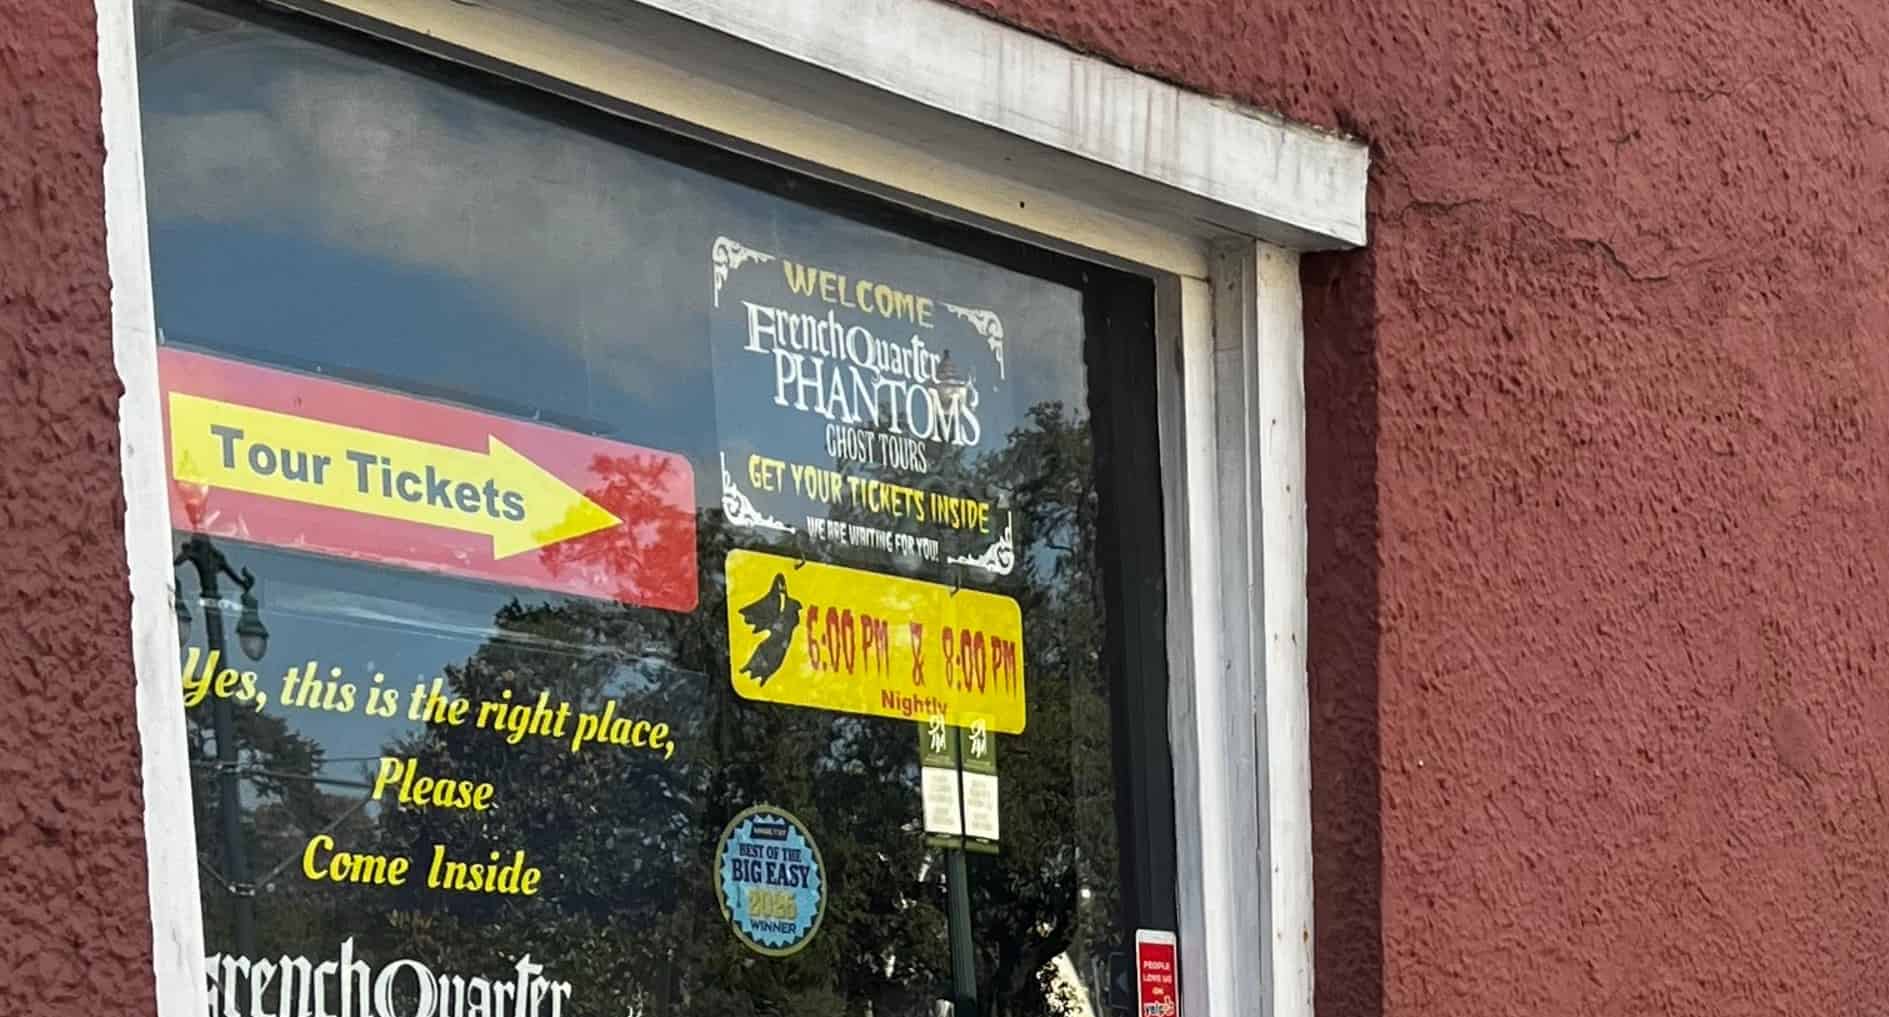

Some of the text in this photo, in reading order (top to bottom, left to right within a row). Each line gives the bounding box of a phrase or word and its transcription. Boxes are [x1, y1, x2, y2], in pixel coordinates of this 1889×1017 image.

[783, 260, 935, 329] WELCOME
[772, 348, 981, 447] PHANTOMS
[210, 423, 527, 522] Tour Tickets
[826, 423, 928, 474] GHOST TOURS
[748, 454, 991, 534] GET YOUR TICKETS INSIDE
[806, 516, 825, 541] WE
[826, 520, 847, 543] ARE
[848, 524, 893, 553] WAITING
[894, 534, 914, 558] FOR
[806, 604, 856, 676] 6:00
[860, 613, 890, 680] PM
[942, 625, 987, 694] 8:00
[990, 635, 1018, 698] PM
[181, 646, 676, 760] Yes, this is the right place,
[880, 689, 948, 718] Nightly
[371, 757, 494, 811] Please
[302, 834, 543, 898] Come Inside
[732, 858, 810, 889] BIG EASY
[739, 843, 802, 862] BEST OF THE
[751, 919, 797, 934] WINNER
